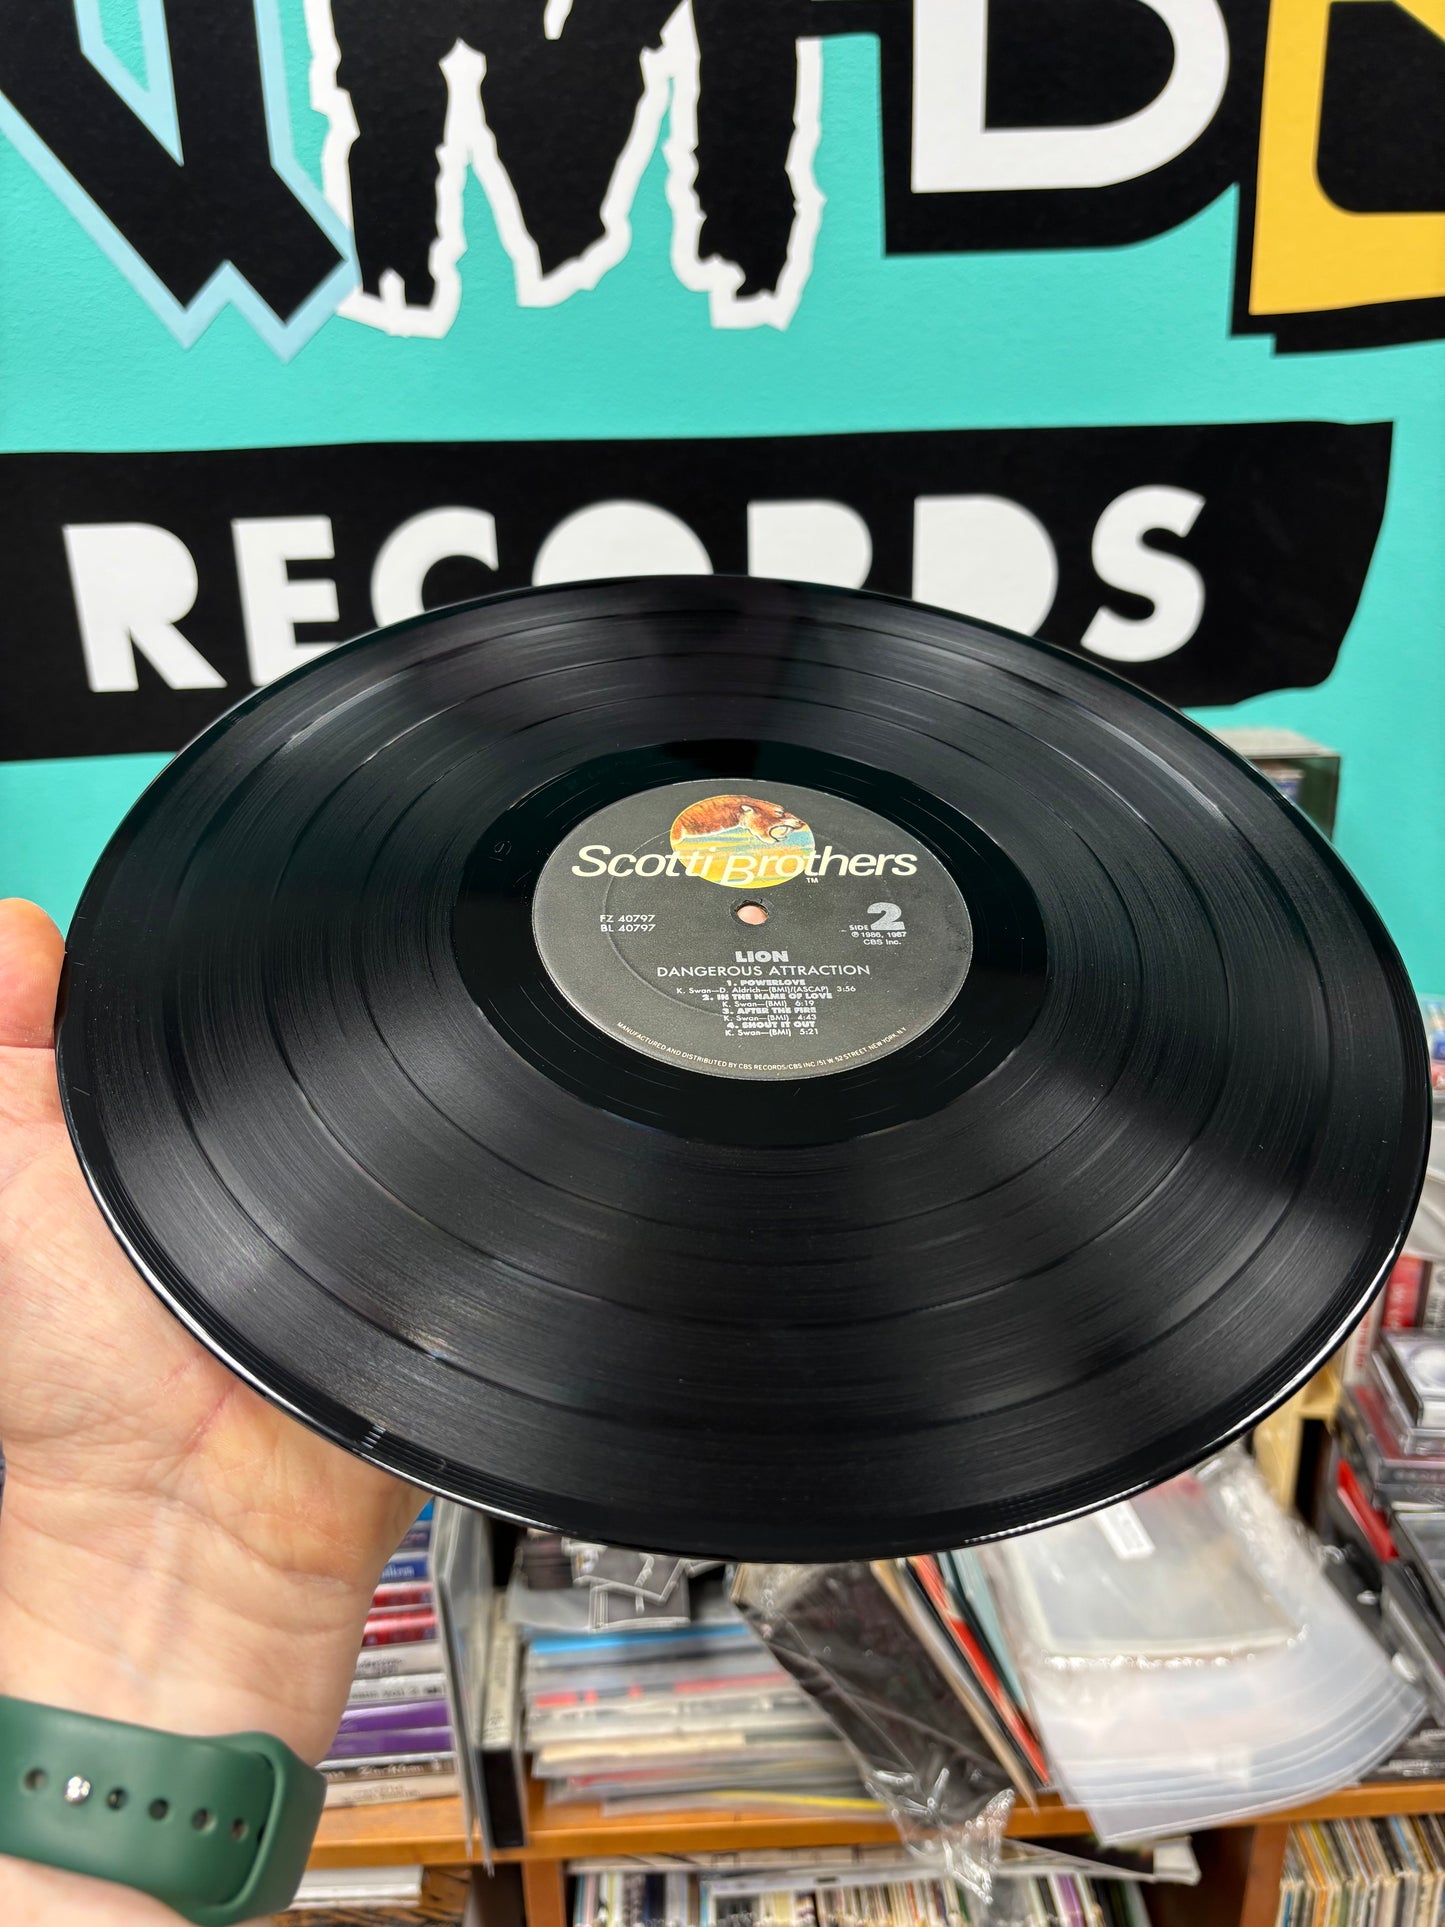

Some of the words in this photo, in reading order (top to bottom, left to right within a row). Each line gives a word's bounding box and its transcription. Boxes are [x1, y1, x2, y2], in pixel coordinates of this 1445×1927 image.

[571, 845, 714, 877] Scotti
[720, 846, 918, 887] Brothers
[600, 914, 614, 923] FZ
[618, 914, 656, 923] 40797
[867, 901, 906, 931] 2
[600, 924, 614, 933] BL
[618, 924, 656, 932] 40797
[861, 931, 884, 939] 1986,
[863, 938, 883, 946] CBS
[885, 938, 902, 946] Inc.
[735, 950, 789, 963] LION
[656, 966, 763, 977] DANGEROUS
[769, 964, 870, 976] ATTRACTION
[617, 1021, 667, 1050] MANUFACTURED
[666, 1047, 682, 1056] AND
[682, 1051, 727, 1068] DISTRIBUTED
[868, 1040, 883, 1051] NEW
